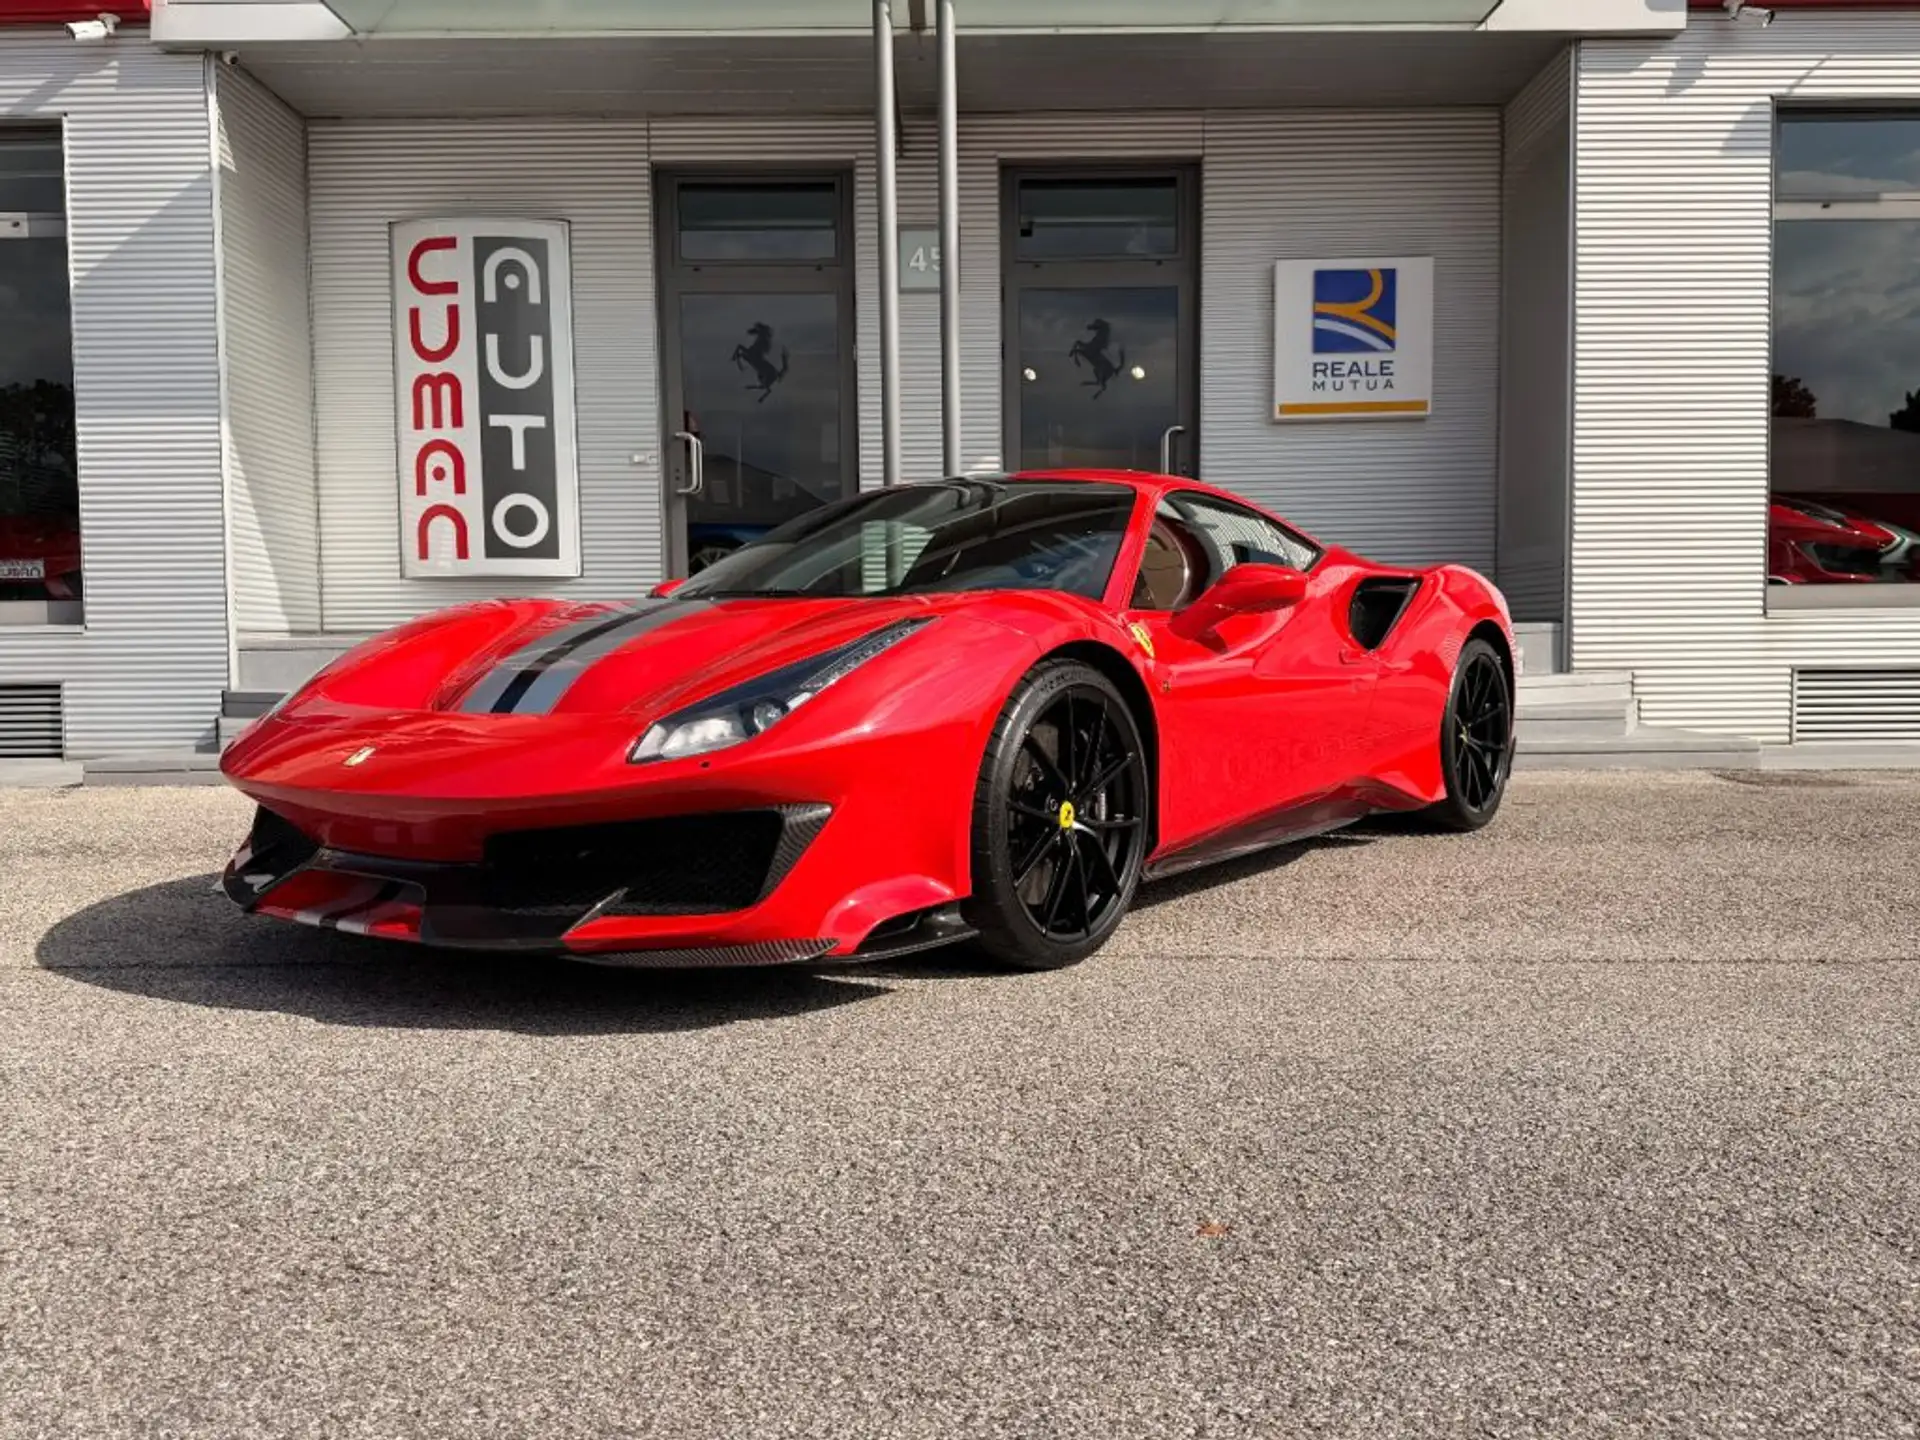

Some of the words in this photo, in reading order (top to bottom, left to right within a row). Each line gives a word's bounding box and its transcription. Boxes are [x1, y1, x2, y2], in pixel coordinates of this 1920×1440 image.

[408, 236, 470, 560] CUMAN
[483, 247, 550, 548] AUTO
[1312, 360, 1395, 378] REALE
[1312, 378, 1395, 392] MUTUA
